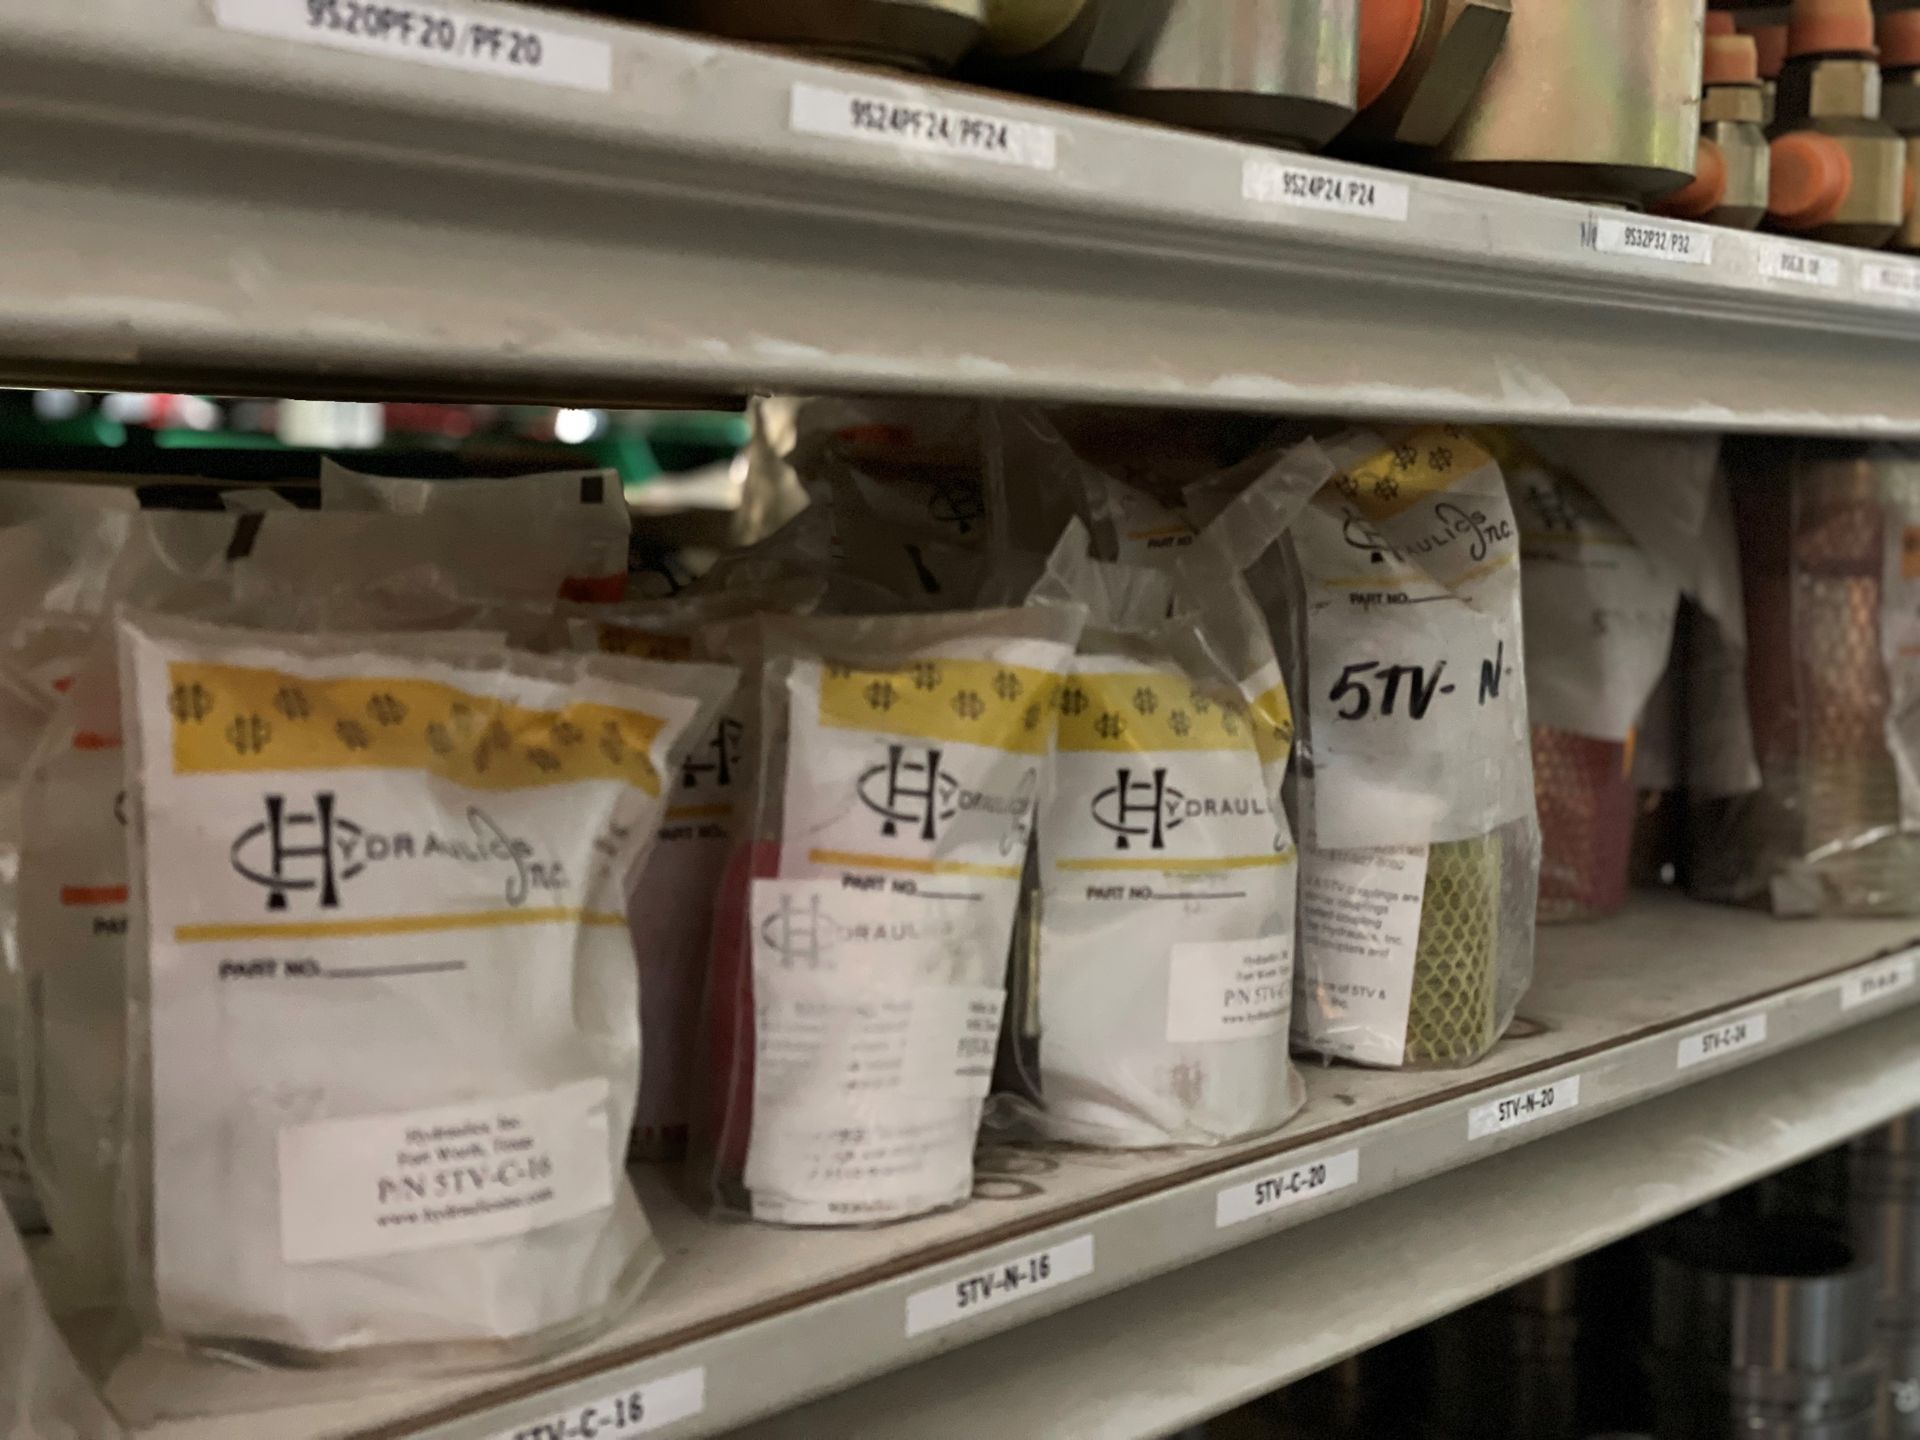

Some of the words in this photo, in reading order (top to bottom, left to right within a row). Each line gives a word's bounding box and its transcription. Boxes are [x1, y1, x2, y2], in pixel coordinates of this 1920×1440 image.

[1624, 226, 1690, 254] 9S32P32/P32
[842, 872, 885, 892] PART
[1086, 886, 1125, 900] PART
[218, 957, 276, 979] PART
[1254, 1163, 1327, 1205] 5TV-C-20
[955, 1254, 1051, 1308] 5TV-N-16
